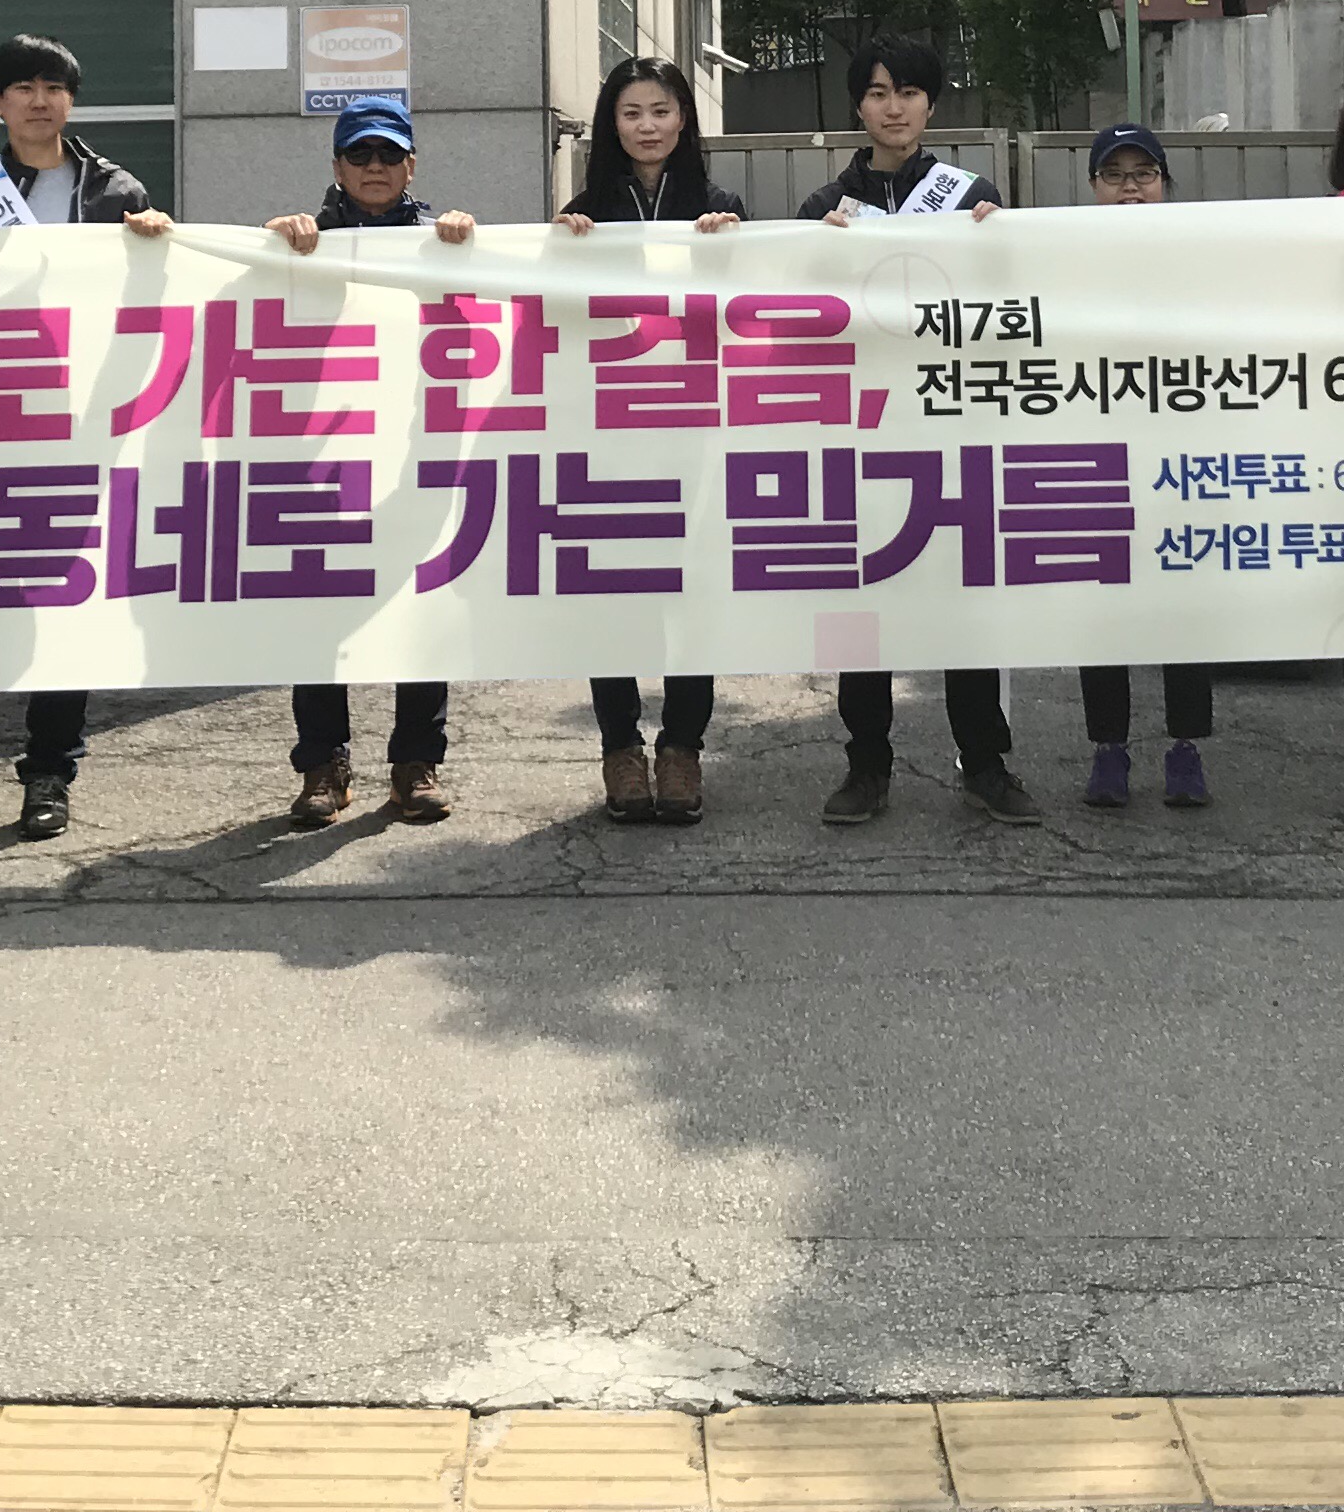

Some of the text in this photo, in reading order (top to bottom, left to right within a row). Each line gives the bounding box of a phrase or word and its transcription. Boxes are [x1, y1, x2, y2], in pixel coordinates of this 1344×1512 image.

[319, 36, 393, 56] ipocom
[914, 297, 1042, 348] 제7회
[111, 298, 379, 438] 가는
[420, 293, 559, 433] 한
[588, 294, 889, 429] 걸음,
[916, 353, 1307, 415] 전국동시지방선거
[1153, 453, 1310, 500] 사전투표
[416, 452, 686, 596] 가는
[726, 443, 1135, 591] 밑거름
[1155, 523, 1270, 570] 선거일
